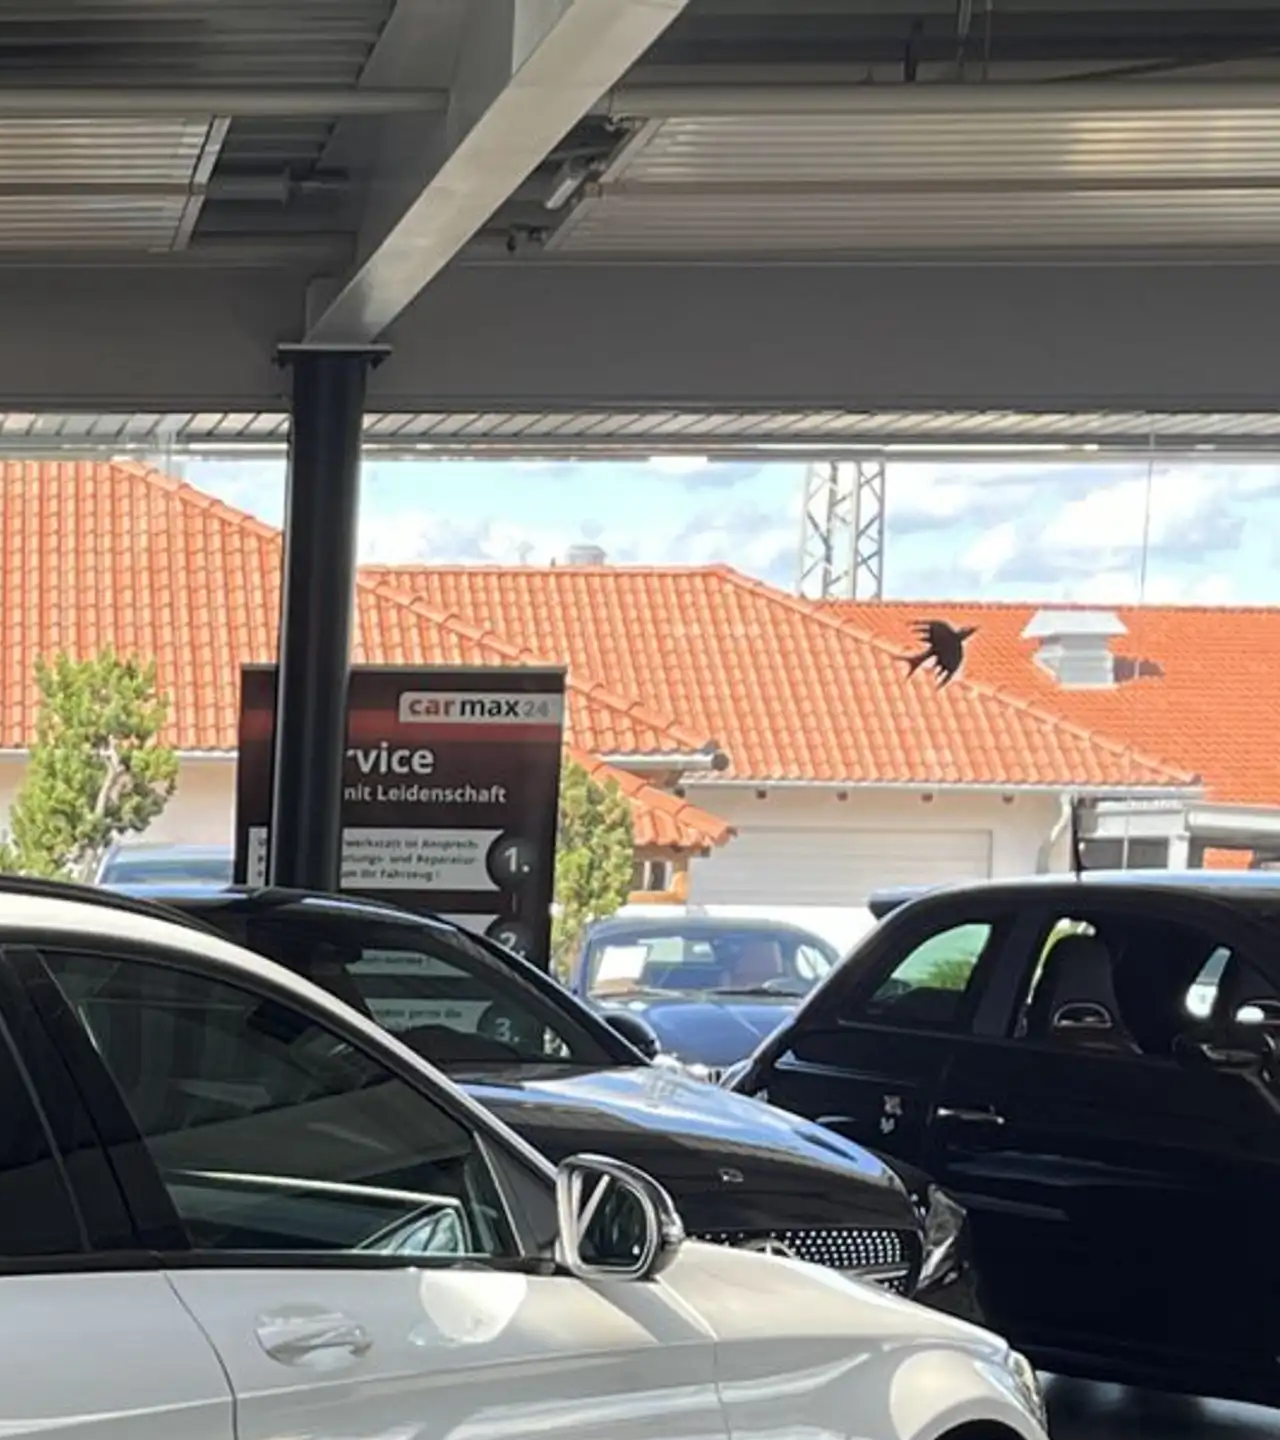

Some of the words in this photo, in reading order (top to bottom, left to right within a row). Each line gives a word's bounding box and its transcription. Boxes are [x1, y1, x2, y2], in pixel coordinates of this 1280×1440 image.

[407, 697, 549, 719] carmax24
[346, 741, 435, 774] vice
[376, 783, 507, 804] Leidenschaft
